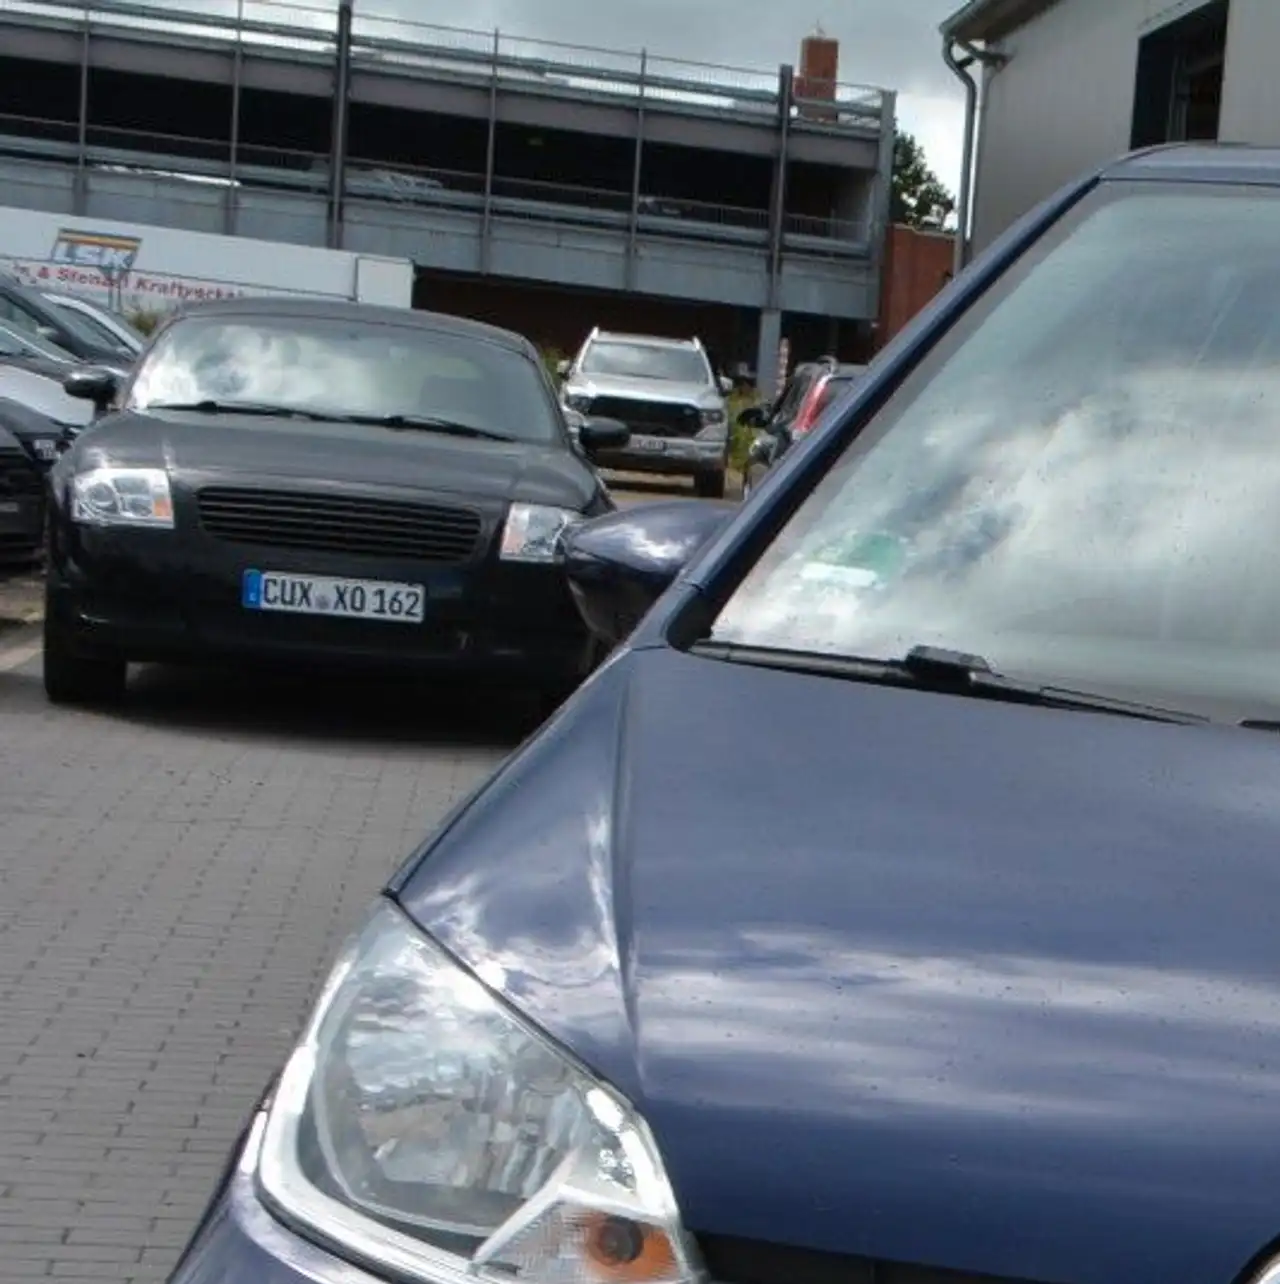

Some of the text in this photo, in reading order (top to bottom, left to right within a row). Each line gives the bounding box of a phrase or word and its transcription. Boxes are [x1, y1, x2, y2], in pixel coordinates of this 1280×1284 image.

[264, 578, 420, 617] CUX XO 162
